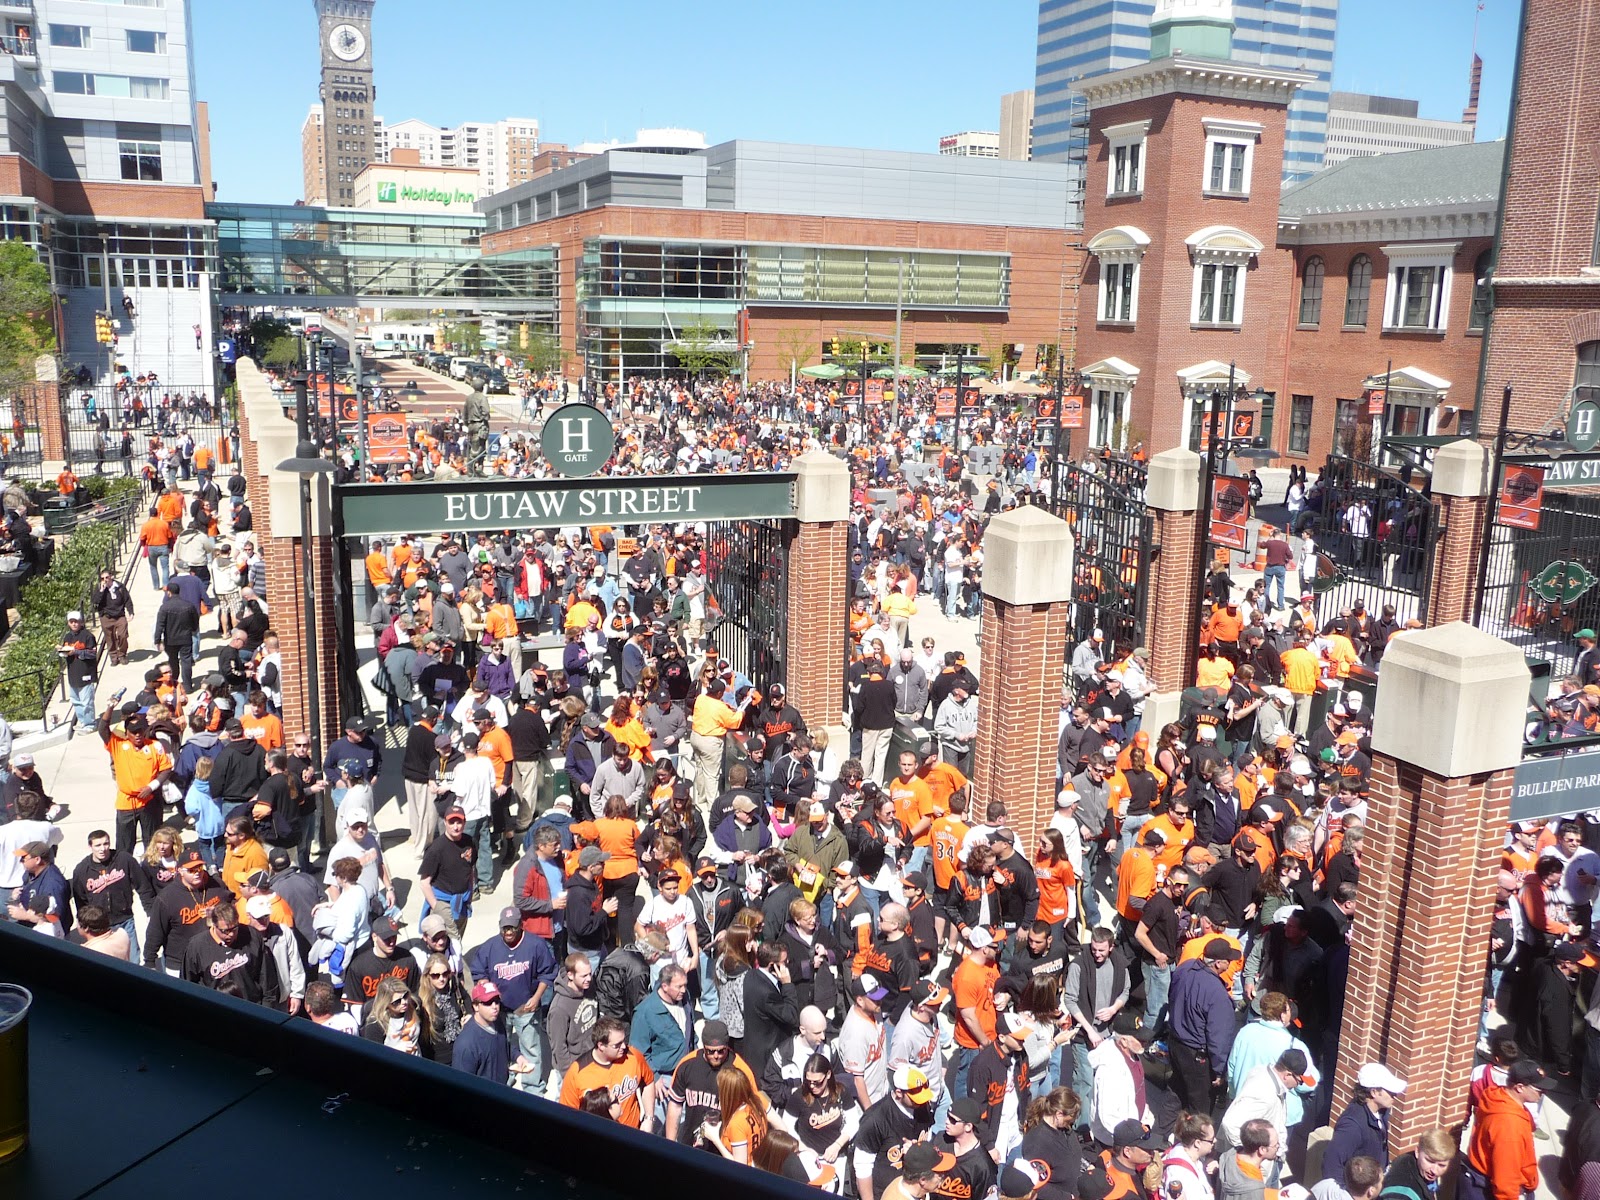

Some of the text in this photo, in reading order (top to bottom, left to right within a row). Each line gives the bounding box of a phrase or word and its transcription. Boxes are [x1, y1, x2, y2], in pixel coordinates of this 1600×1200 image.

[401, 186, 475, 205] Holiday Inn
[218, 342, 230, 353] P
[1574, 409, 1594, 435] H
[558, 417, 593, 453] H
[564, 454, 588, 463] GATE
[444, 486, 701, 521] EUTAW STREET
[765, 721, 793, 737] Orioles
[1196, 714, 1219, 725] JONES
[1517, 778, 1573, 798] BULLPEN
[936, 841, 955, 864] 34
[210, 953, 249, 979] Orioles
[494, 960, 530, 981] Twins
[809, 1106, 841, 1130] Orioles
